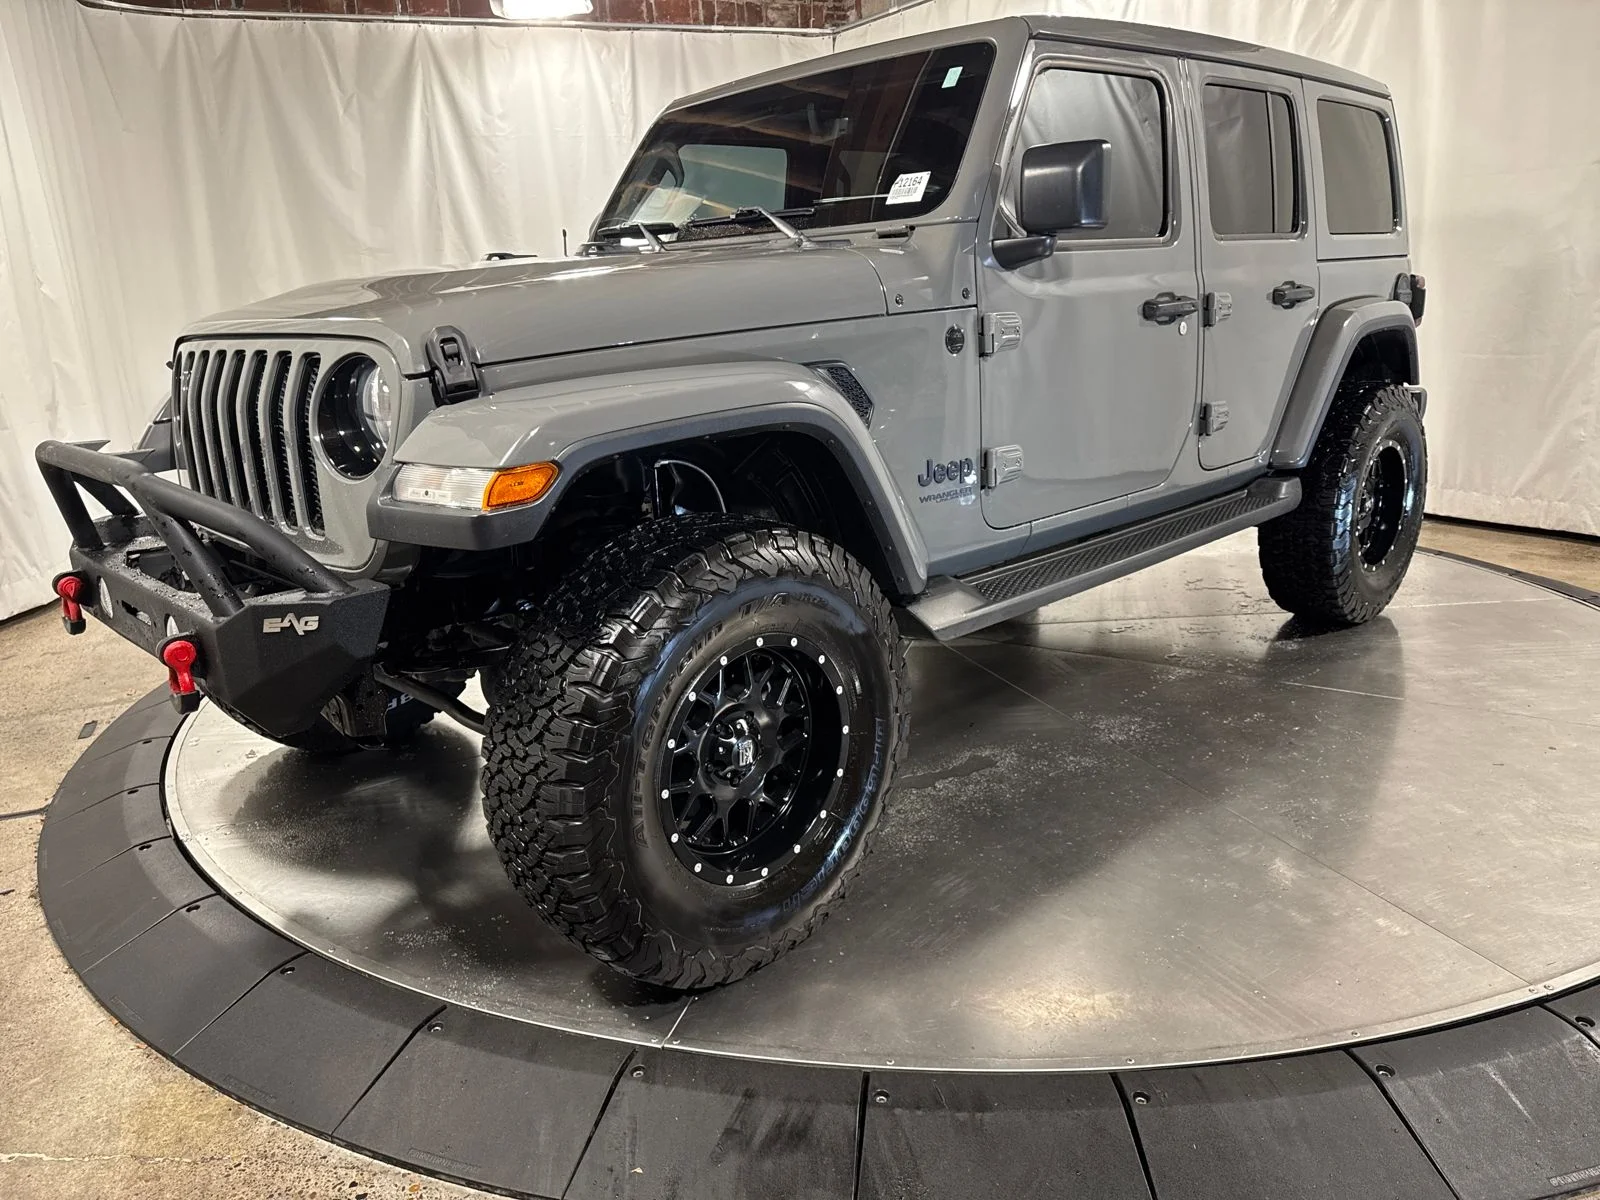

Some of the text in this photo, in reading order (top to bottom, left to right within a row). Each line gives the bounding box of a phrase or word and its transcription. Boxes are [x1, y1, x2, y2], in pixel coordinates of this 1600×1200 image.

[918, 458, 973, 487] Jeep
[919, 487, 972, 503] WRANGLER
[263, 612, 319, 636] EAG
